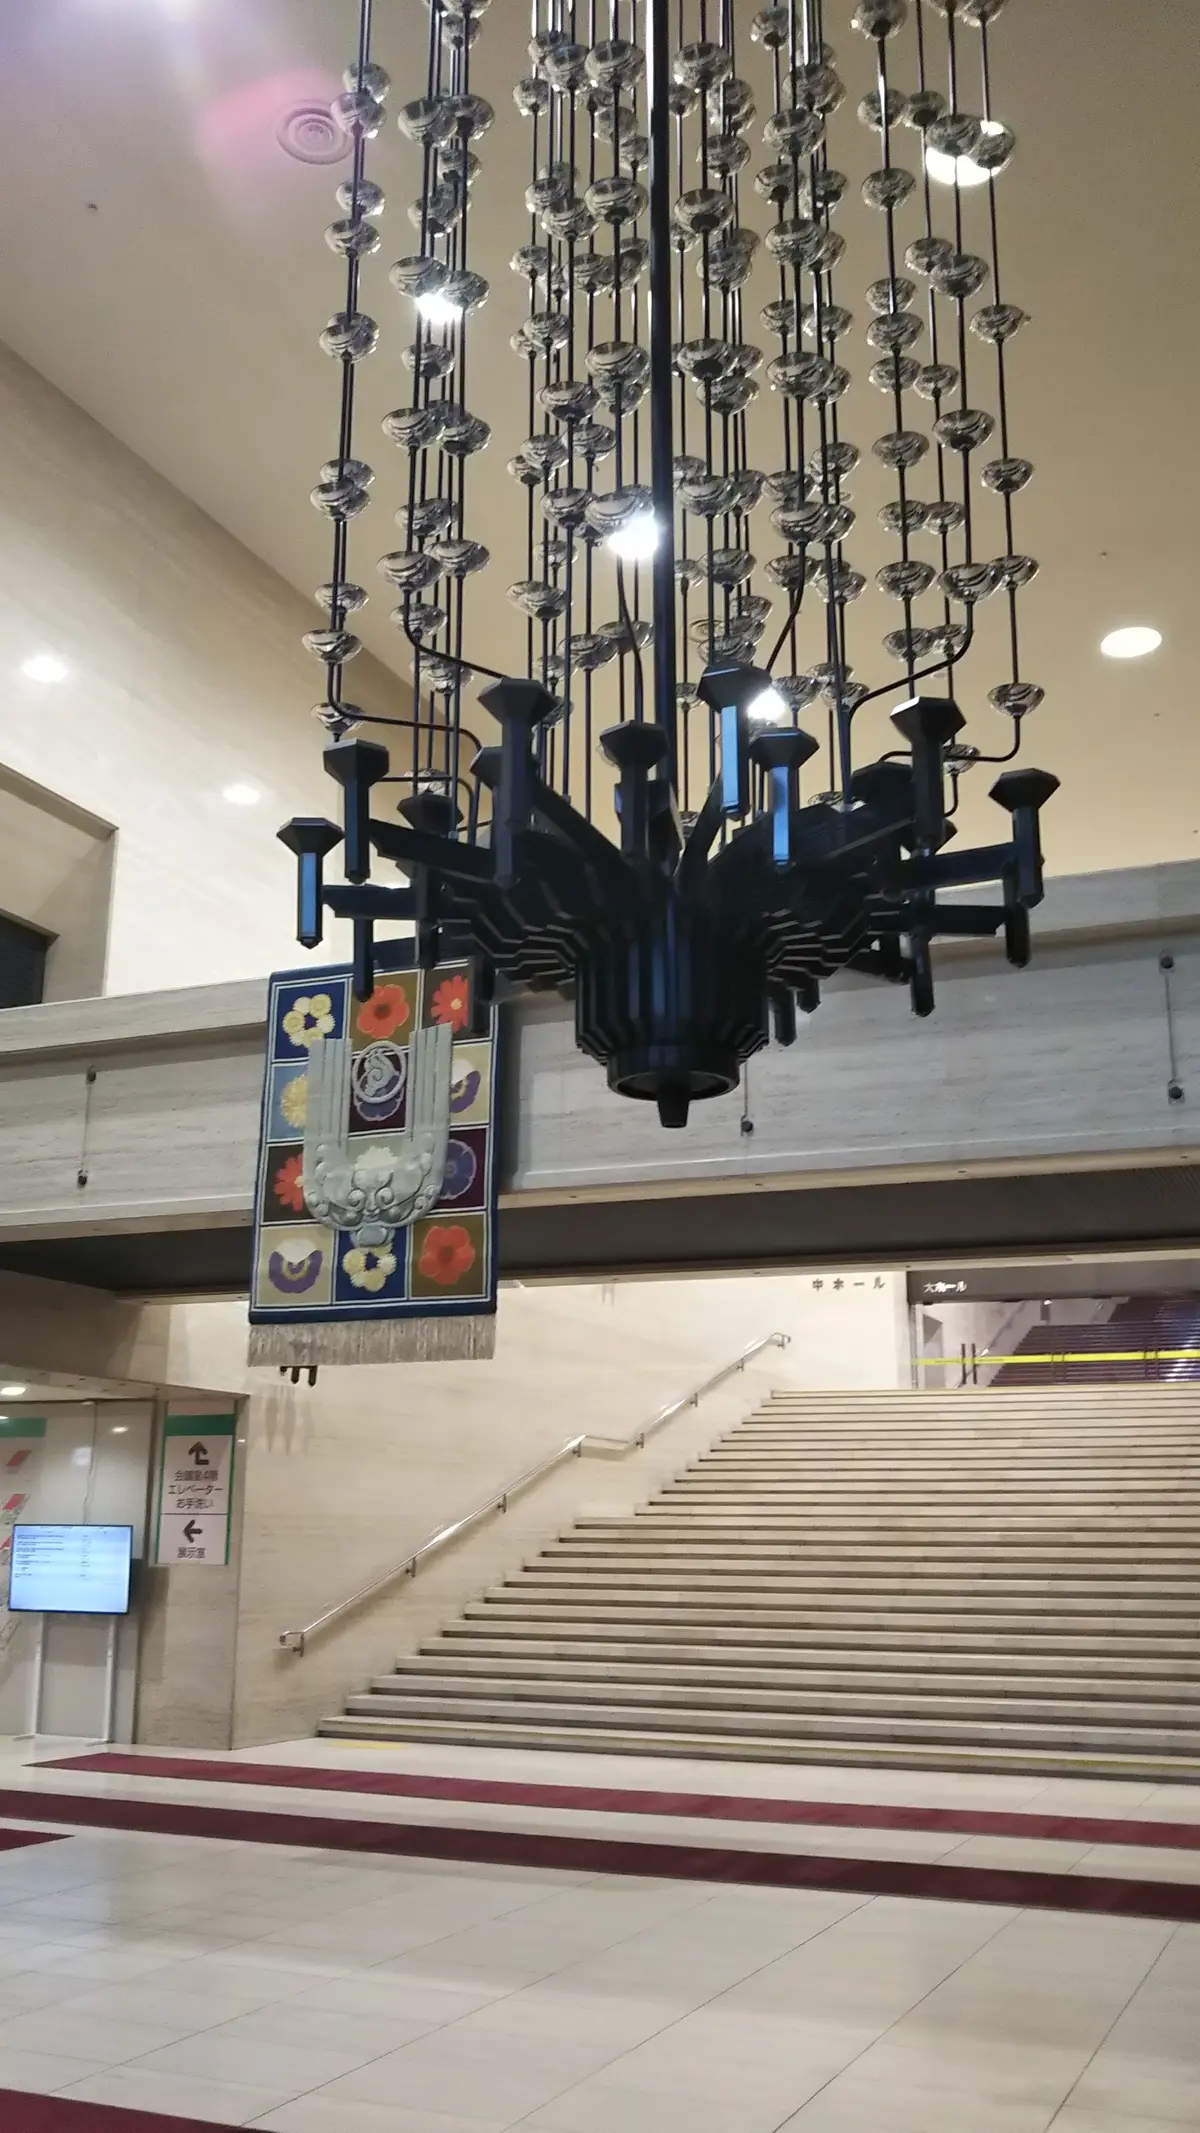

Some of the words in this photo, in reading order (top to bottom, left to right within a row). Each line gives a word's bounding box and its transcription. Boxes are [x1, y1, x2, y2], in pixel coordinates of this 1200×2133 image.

[924, 1280, 968, 1293] 大ホール
[168, 1484, 223, 1496] エレベーター
[175, 1497, 215, 1510] お手洗い
[177, 1546, 206, 1559] 展示室
